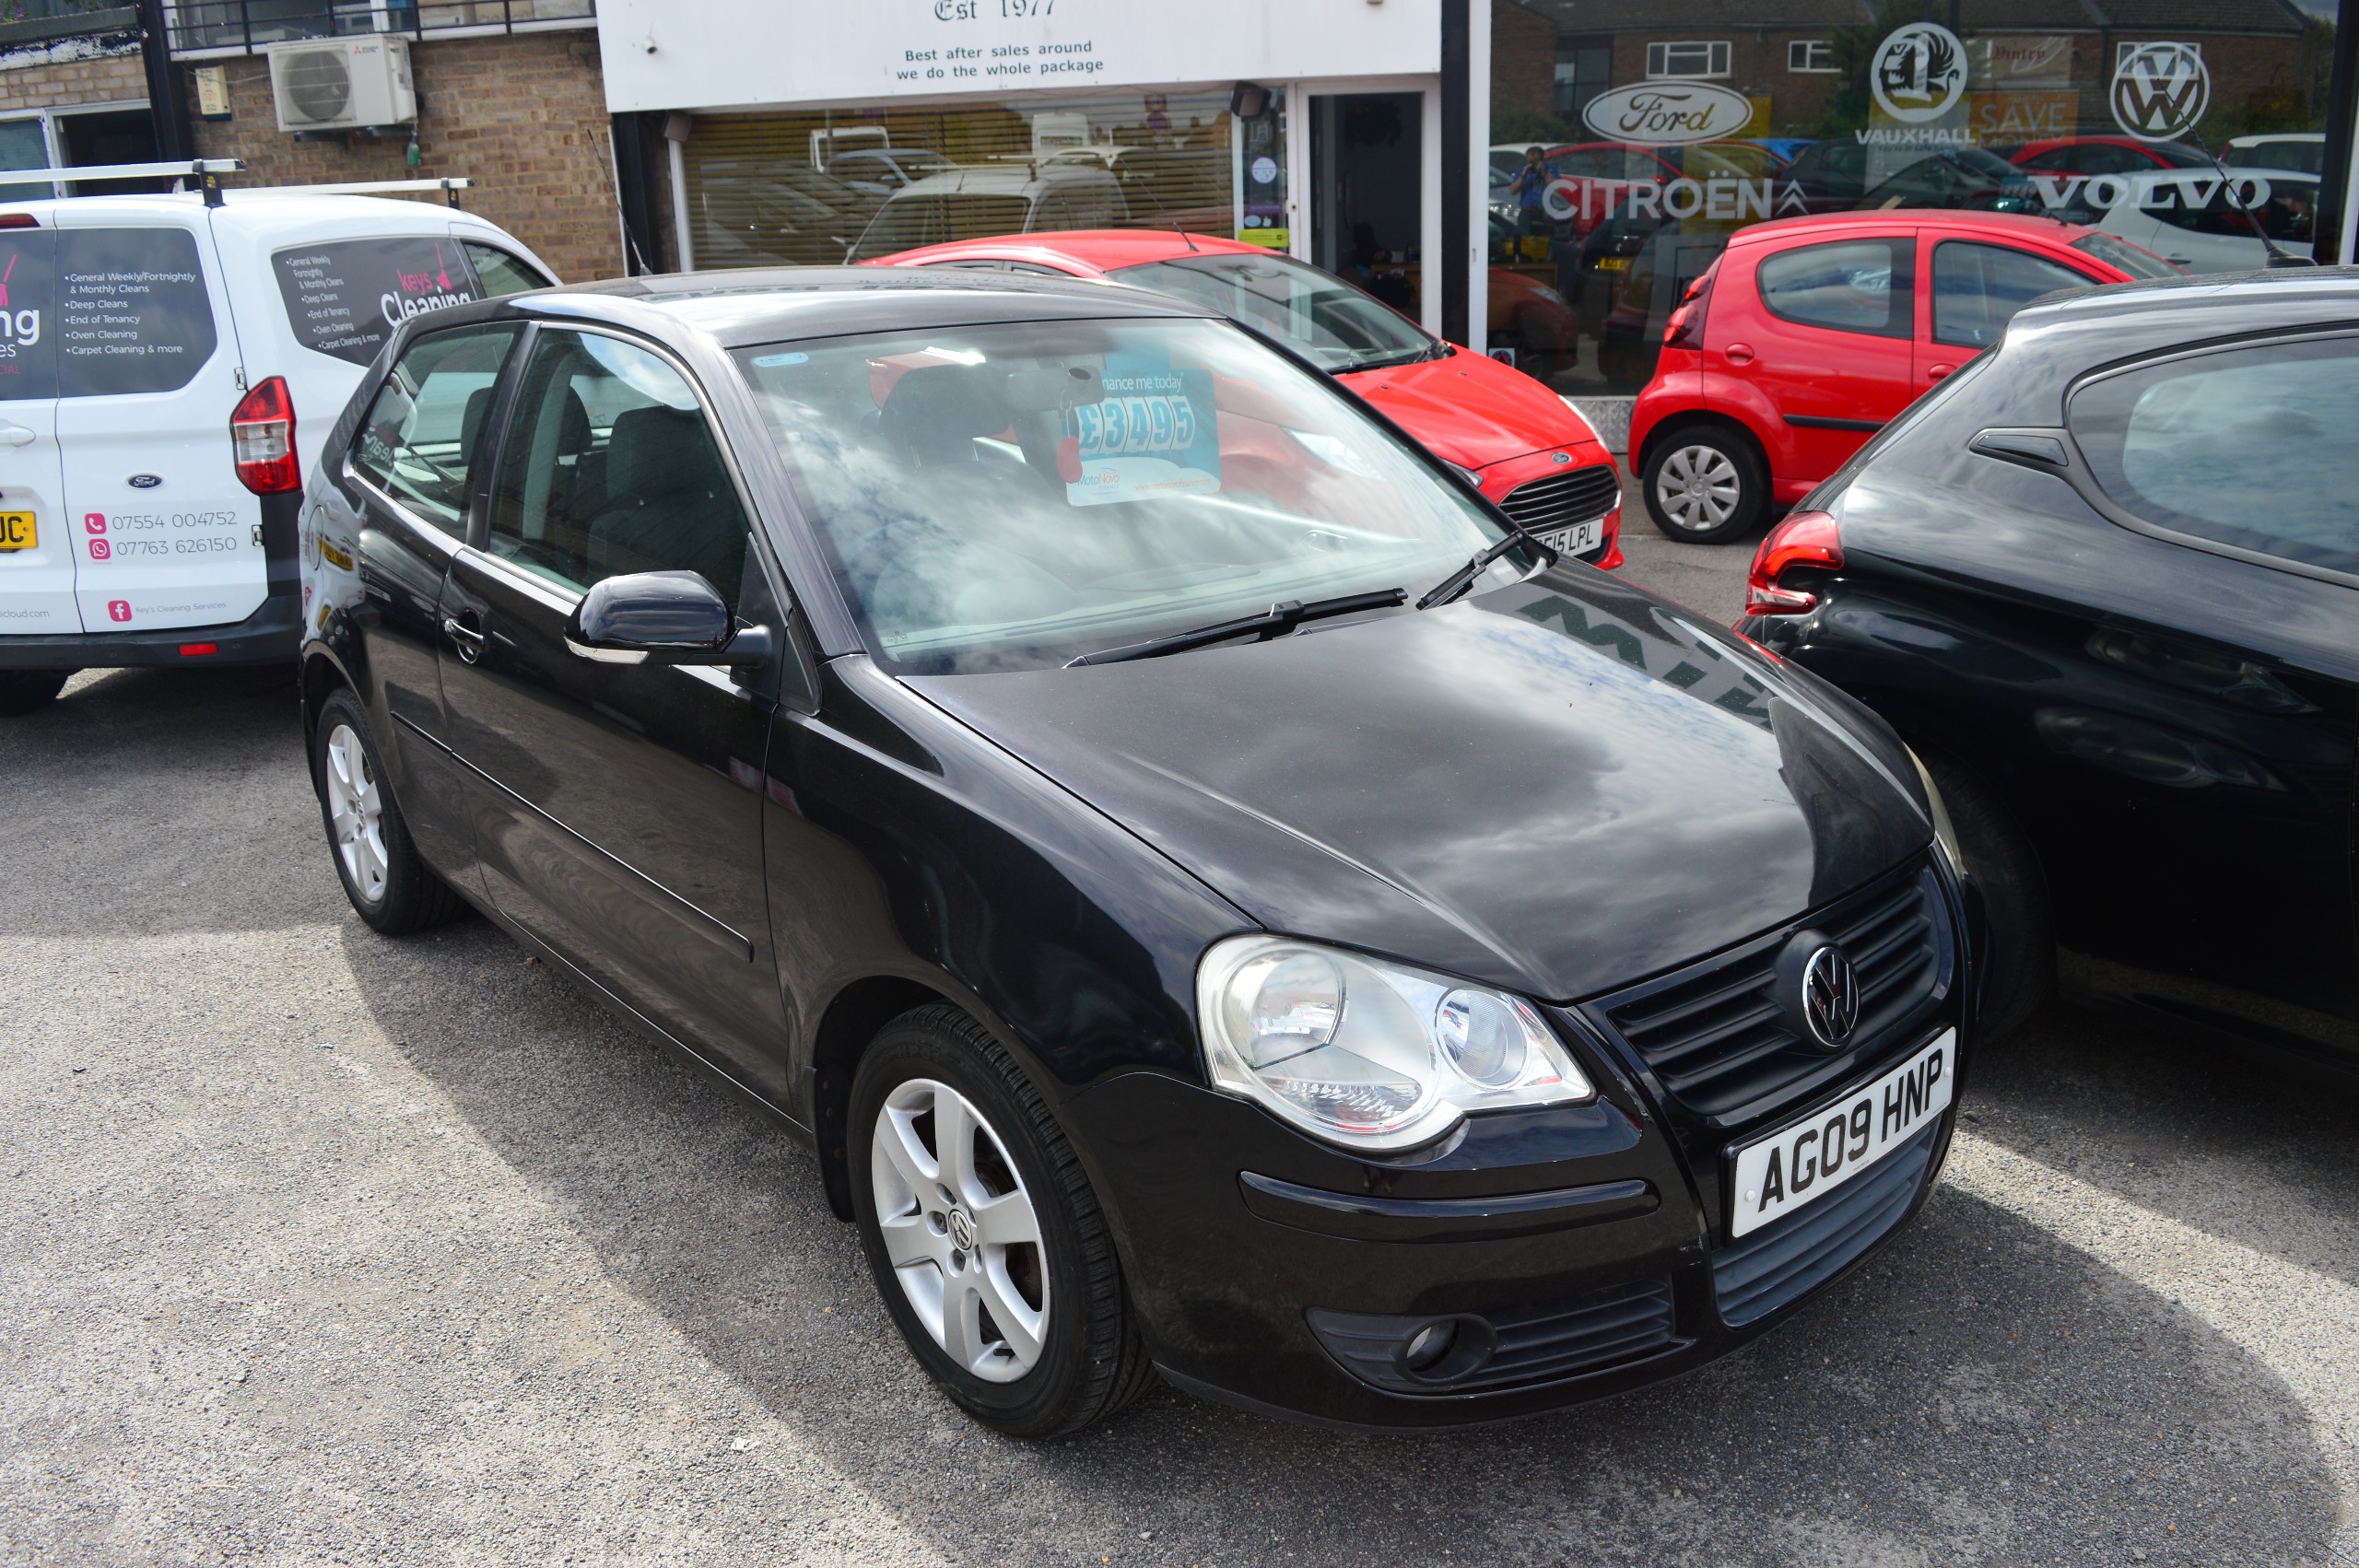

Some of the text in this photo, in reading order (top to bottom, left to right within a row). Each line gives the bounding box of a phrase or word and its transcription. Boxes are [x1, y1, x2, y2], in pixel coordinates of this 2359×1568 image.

[905, 41, 1093, 62] Best after sales around
[897, 59, 1104, 80] we do the whole package
[1618, 92, 1716, 132] Ford
[1980, 102, 2067, 134] SAVE
[1855, 128, 1977, 145] VAUXHALL
[1542, 170, 1773, 220] CITROËN
[2027, 174, 2271, 210] VOLVO
[70, 271, 196, 283] General Weekly/Fortnightly
[397, 269, 434, 296] keys
[70, 284, 150, 295] & Monthly Cleans
[70, 299, 129, 310] Deep Cleans
[70, 314, 141, 325] End of Tenancy
[71, 329, 138, 340] Oven Cleaning
[71, 345, 183, 357] Carpet Cleaning & more
[1136, 377, 1153, 390] me
[1079, 400, 1194, 450] £3495
[112, 510, 238, 531] 07554 004752
[116, 536, 237, 556] 07763 626150
[1568, 524, 1593, 551] LPL
[135, 602, 228, 614] Key's Cleaning Services
[1757, 1047, 1943, 1213] AG09 HNP
